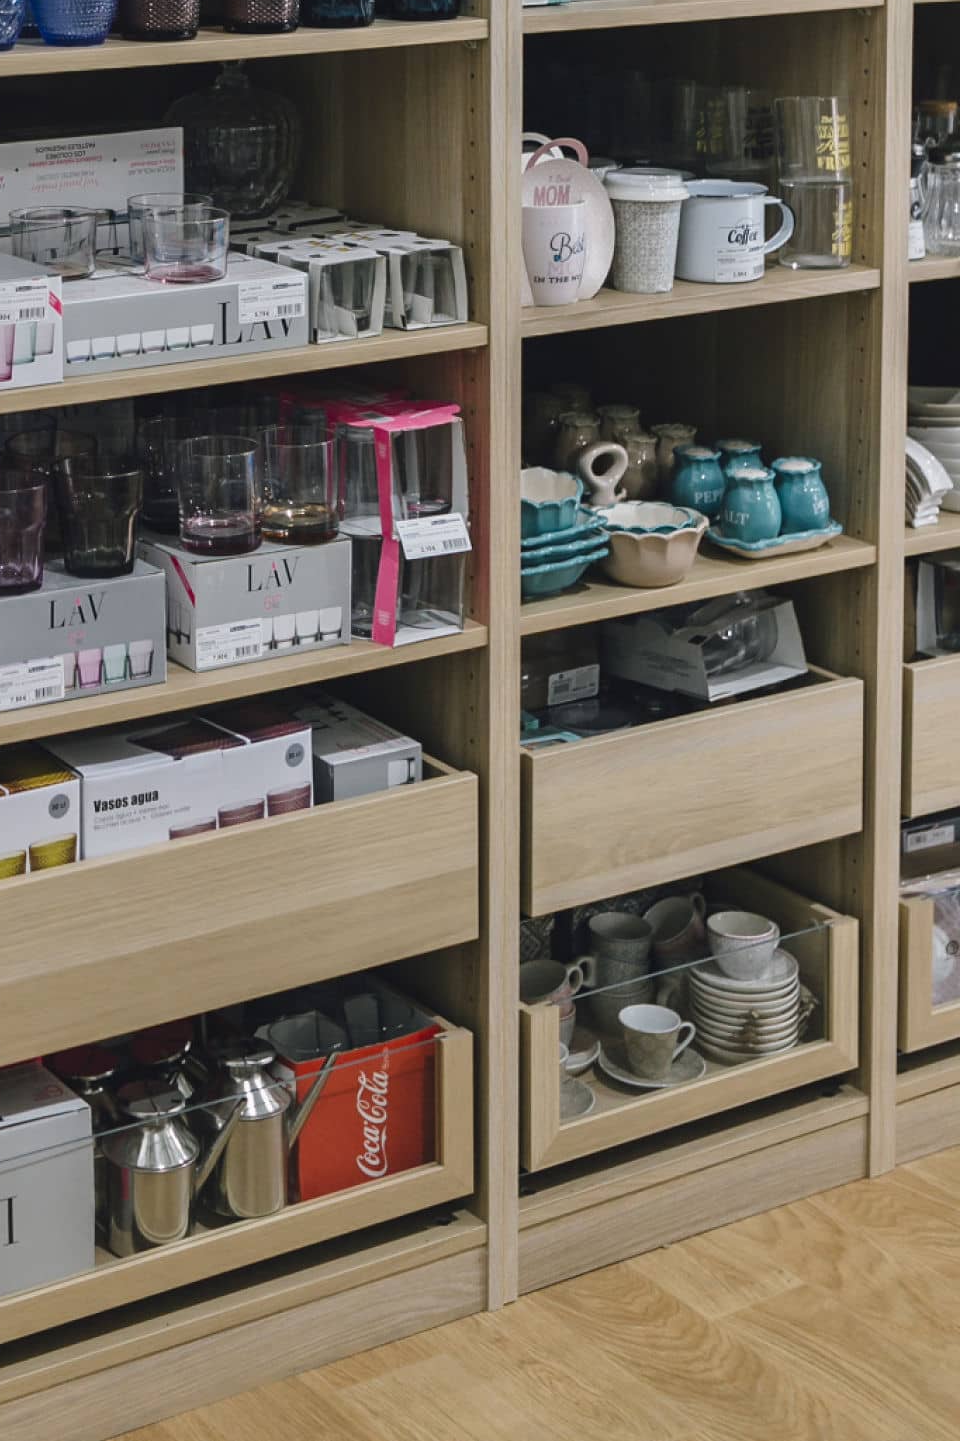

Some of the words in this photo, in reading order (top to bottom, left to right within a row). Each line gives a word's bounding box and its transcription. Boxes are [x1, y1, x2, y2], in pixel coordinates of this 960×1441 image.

[533, 185, 570, 206] MOM
[727, 226, 758, 246] Coffee
[547, 275, 568, 284] THE
[247, 557, 301, 592] LAV
[48, 591, 107, 629] LAV
[93, 796, 128, 812] Vasos
[131, 790, 159, 807] agua
[356, 1069, 389, 1177] Coca-Cola
